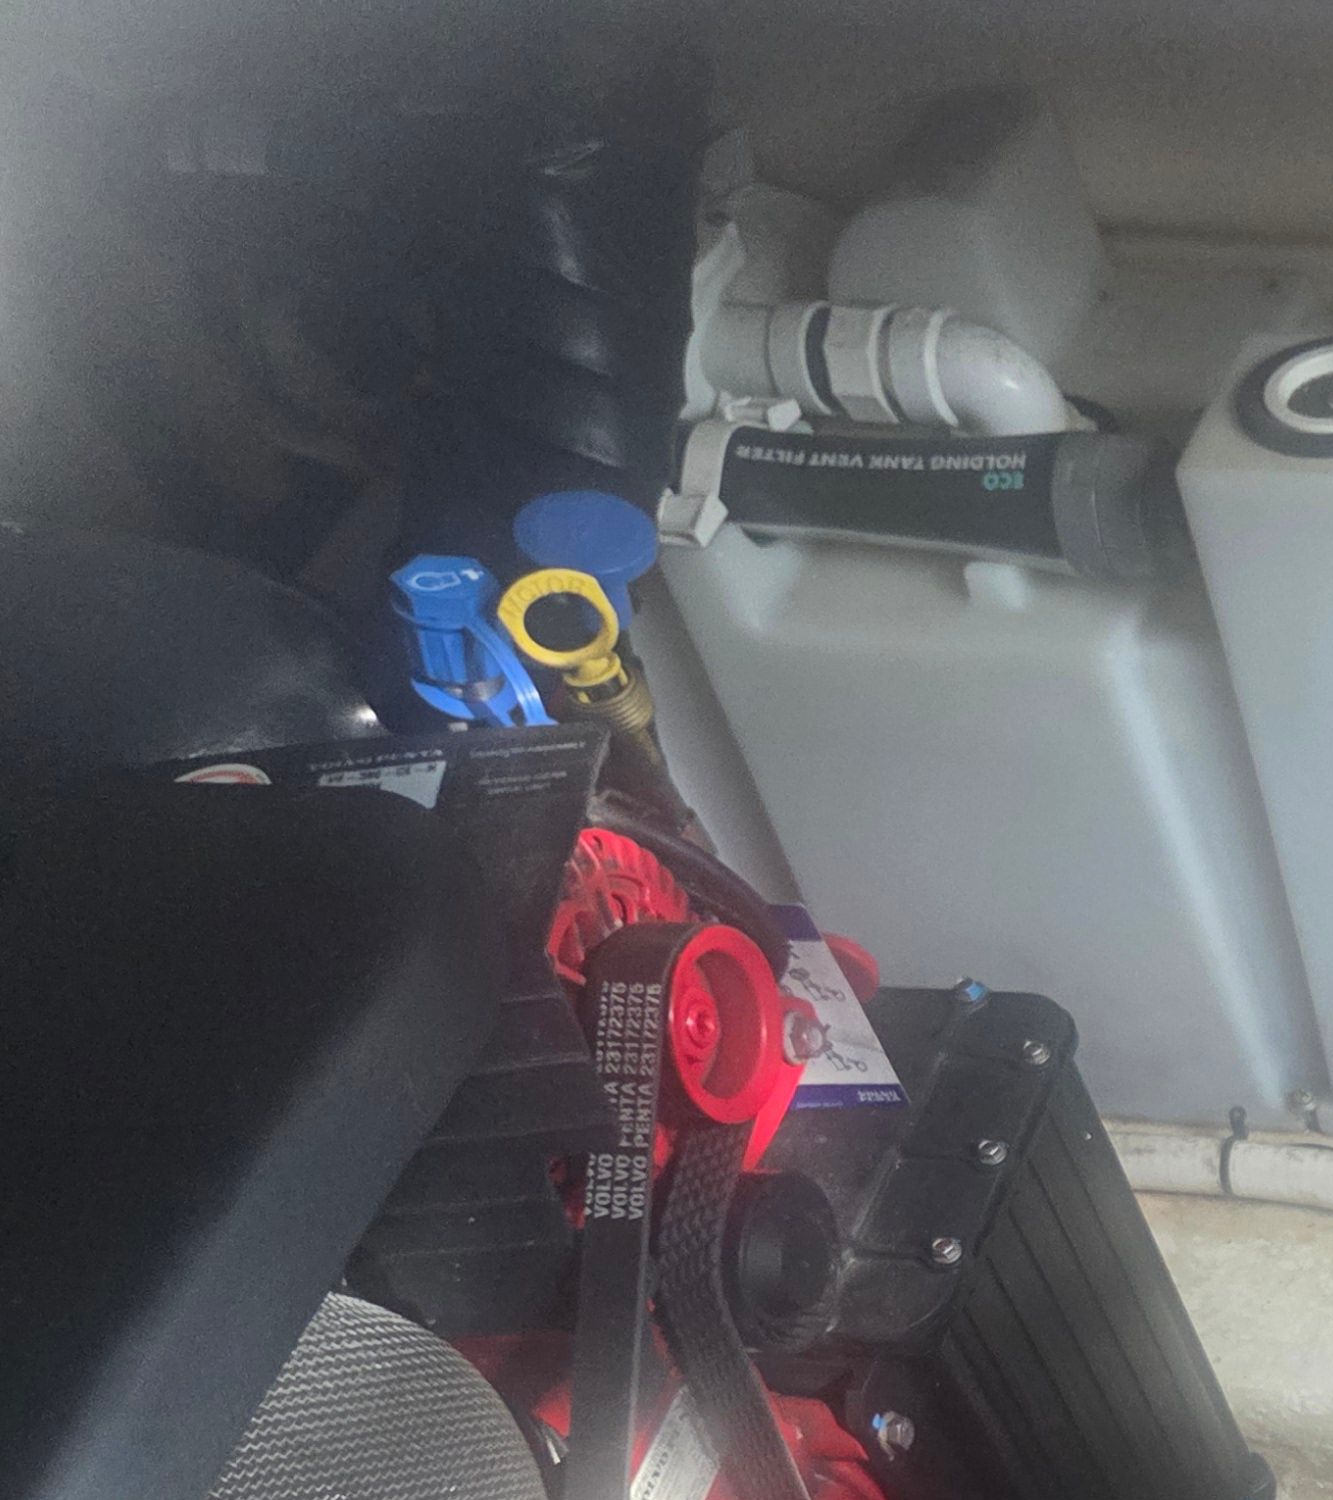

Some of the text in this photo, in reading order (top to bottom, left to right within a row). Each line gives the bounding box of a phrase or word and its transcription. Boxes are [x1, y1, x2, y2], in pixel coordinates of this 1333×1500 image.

[736, 445, 1026, 472] HOLDING TANK VENT FILTER
[982, 472, 1025, 491] ECO
[634, 1082, 652, 1148] PENTA
[594, 1153, 613, 1219] VOLVO
[611, 1155, 630, 1219] VOLVO
[628, 1156, 647, 1220] VOLVO
